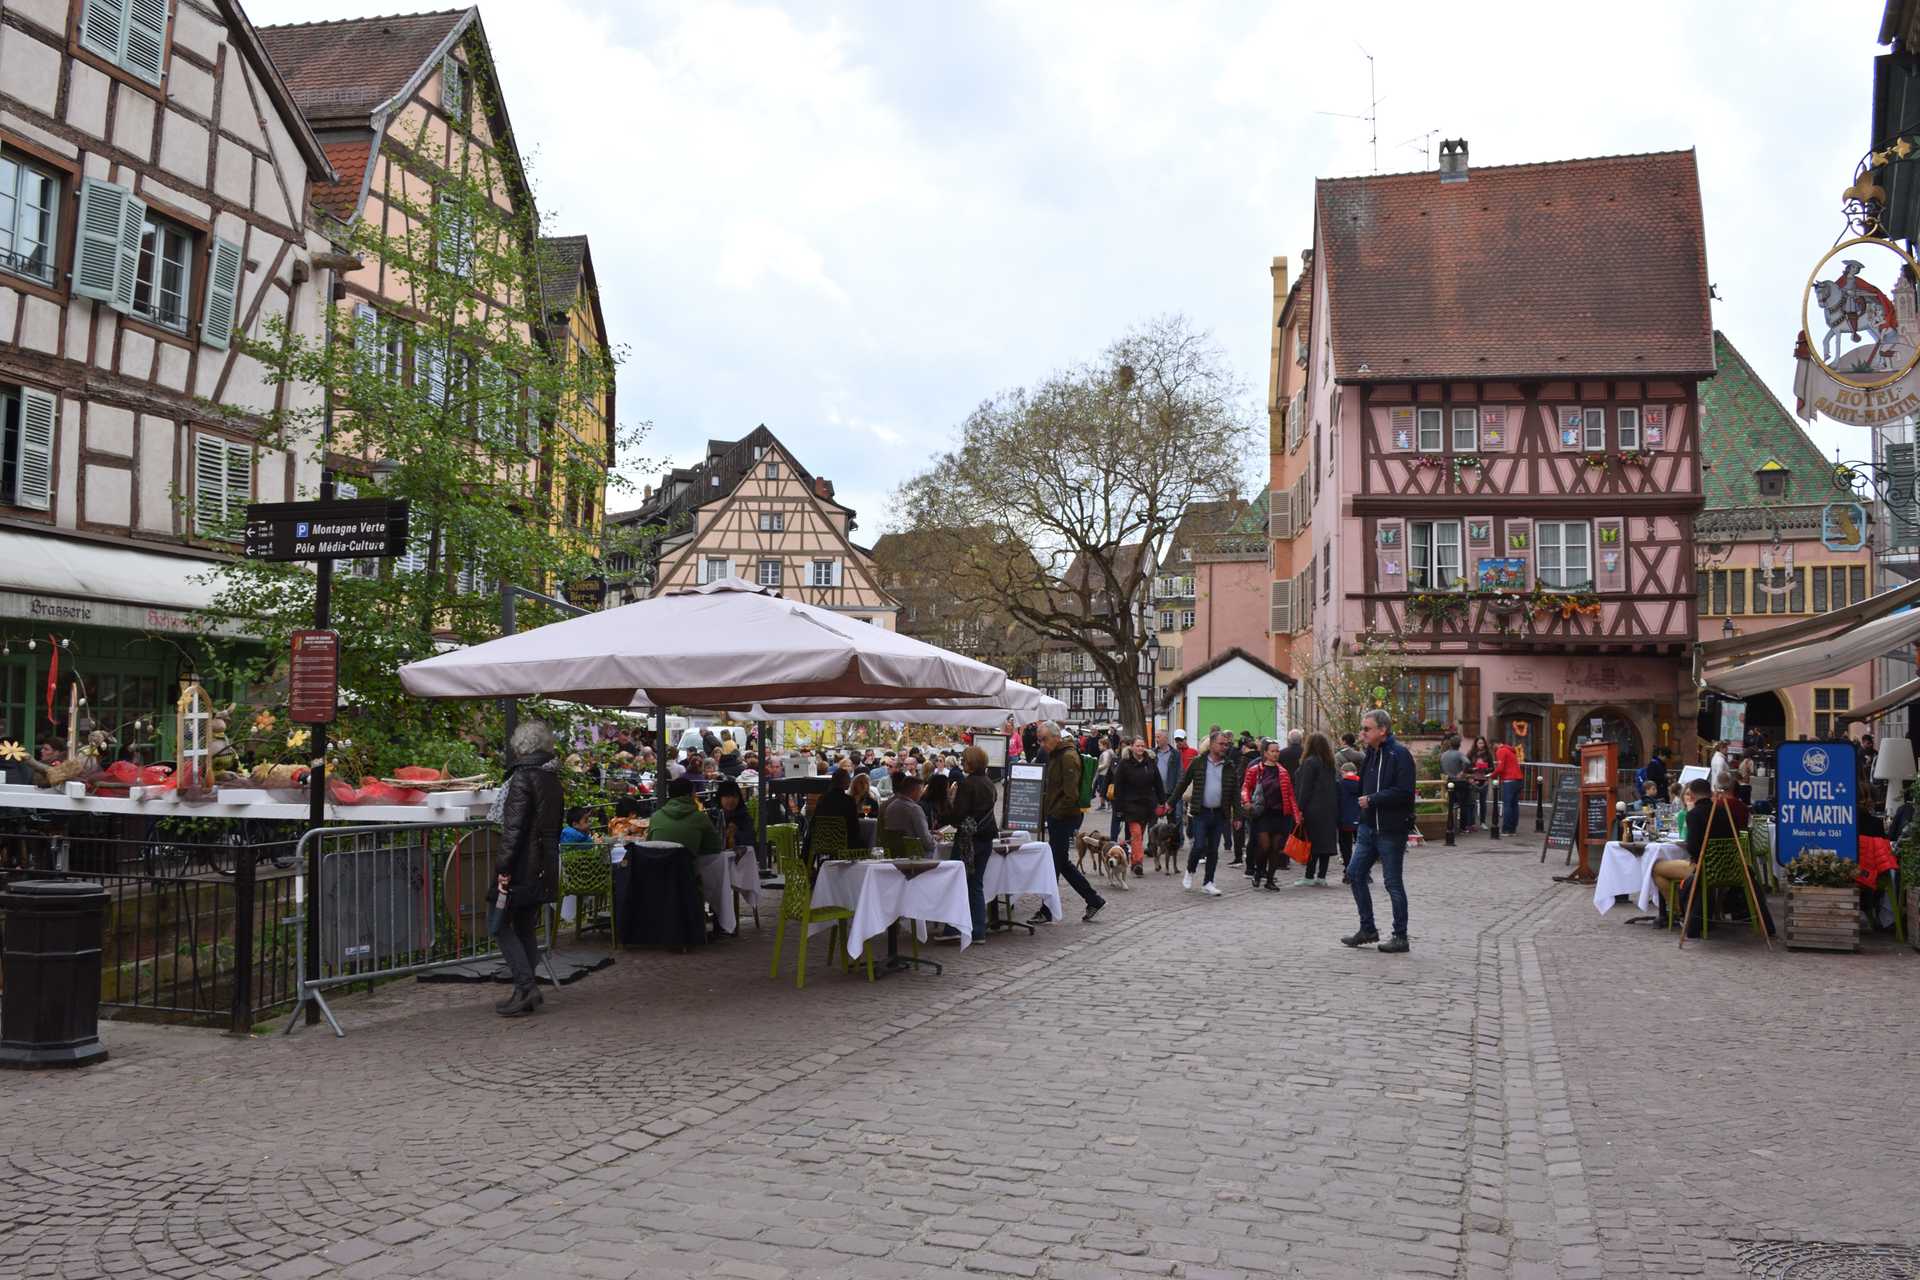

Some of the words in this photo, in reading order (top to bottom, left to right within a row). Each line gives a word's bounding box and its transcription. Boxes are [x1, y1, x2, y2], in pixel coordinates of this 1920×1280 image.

[1836, 389, 1899, 407] HOTEL
[312, 524, 356, 537] Montagne
[360, 522, 385, 533] Verte
[295, 543, 315, 554] Pôle
[318, 541, 385, 552] Média-Culture
[30, 597, 91, 620] Brasserie
[1788, 780, 1835, 800] HOTEL
[1781, 804, 1795, 824] ST
[1801, 805, 1853, 824] MARTIN
[1792, 829, 1816, 837] Maison
[1818, 829, 1826, 837] de
